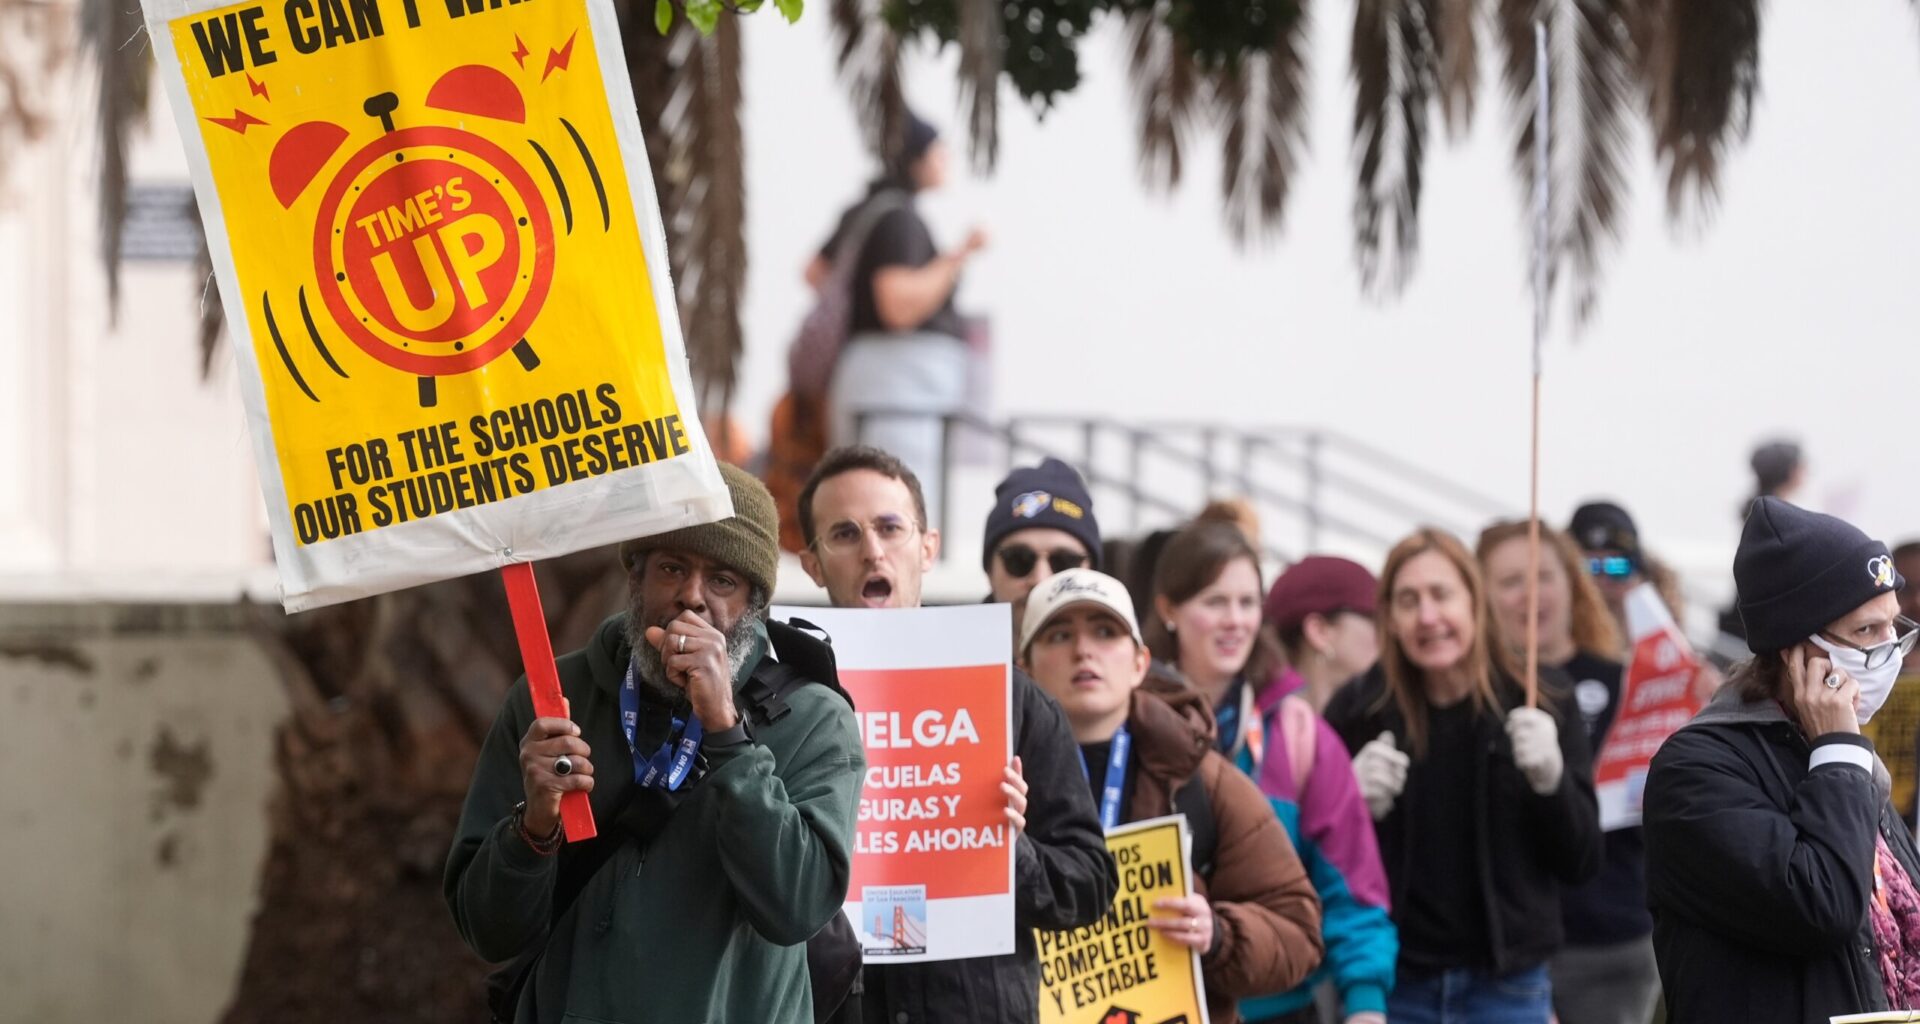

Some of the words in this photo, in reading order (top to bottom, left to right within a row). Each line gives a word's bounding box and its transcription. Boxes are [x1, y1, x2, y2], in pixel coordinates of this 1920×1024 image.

[190, 6, 278, 79] WE
[355, 176, 473, 248] TIME'S
[370, 213, 506, 332] UP
[326, 437, 393, 489] FOR
[397, 420, 465, 473] THE
[469, 383, 622, 457] SCHOOLS
[294, 492, 362, 545] OUR
[367, 452, 535, 527] STUDENTS
[540, 414, 689, 487] DESERVE
[864, 762, 961, 789] CUELAS
[854, 831, 899, 855] LES
[904, 825, 1004, 853] AHORA!
[857, 796, 940, 822] GURAS
[943, 795, 961, 818] Y
[1125, 860, 1173, 893] CON
[1041, 926, 1150, 987] COMPLETO
[1052, 988, 1064, 1016] Y
[1072, 953, 1158, 1008] ESTABLE
